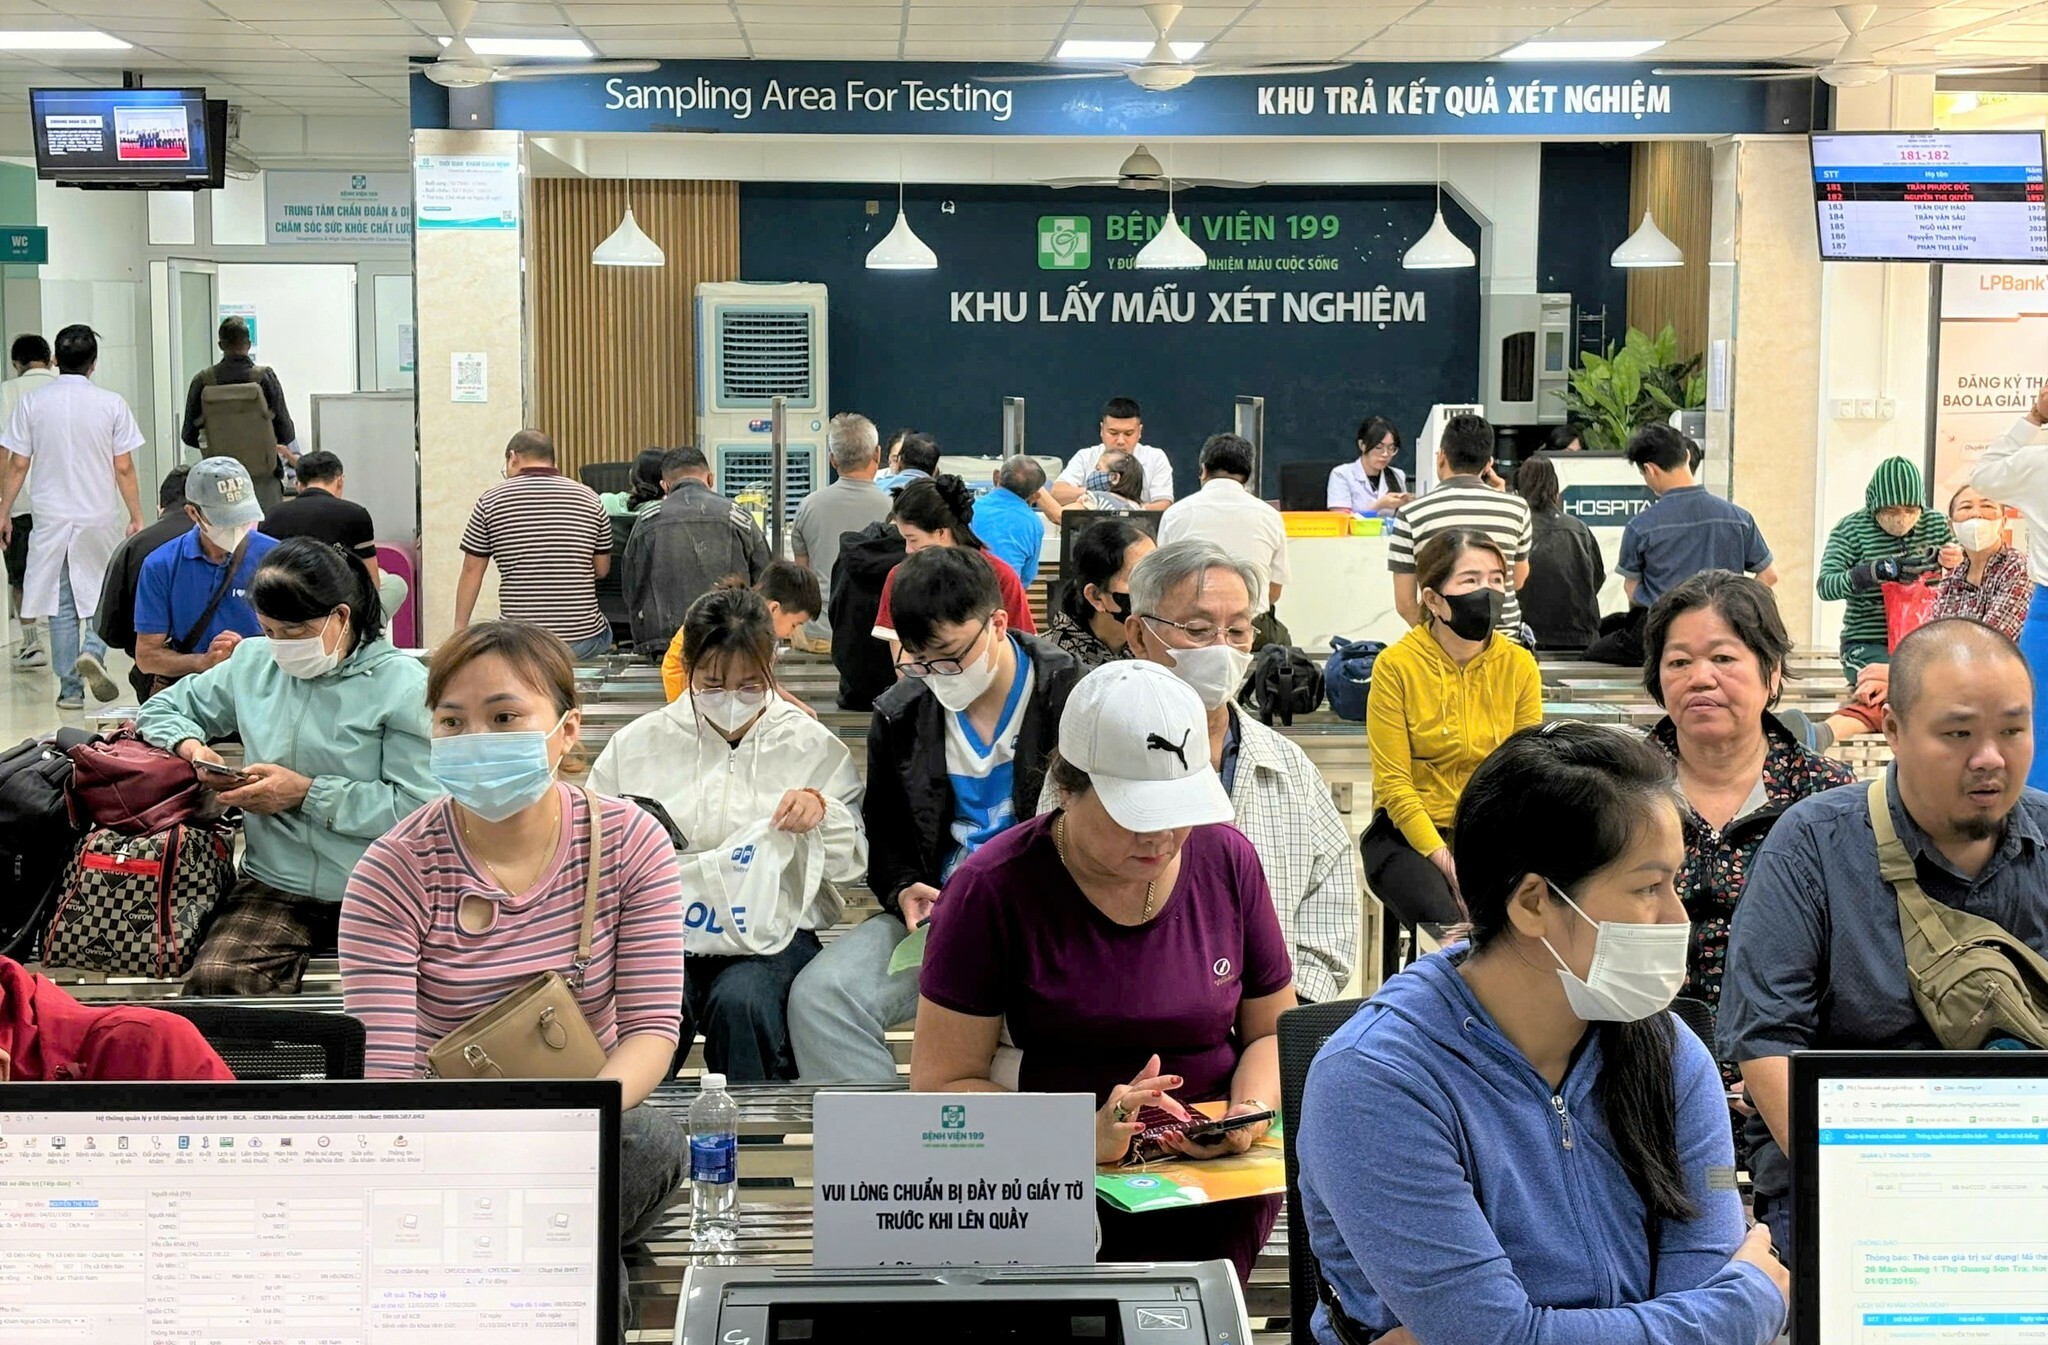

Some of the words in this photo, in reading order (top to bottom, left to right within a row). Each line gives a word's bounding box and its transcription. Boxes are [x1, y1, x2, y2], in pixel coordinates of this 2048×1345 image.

[605, 77, 752, 119] Sampling
[762, 80, 836, 111] Area
[847, 81, 898, 112] For
[902, 81, 1013, 121] Testing
[1257, 86, 1314, 114] KHU
[1324, 78, 1377, 114] TRẢ
[1387, 78, 1441, 115] KẾT
[1444, 76, 1500, 118] QUẢ
[1507, 79, 1558, 114] XÉT
[1564, 80, 1671, 120] NGHIỆM
[1900, 150, 1950, 160] 181-182
[1823, 170, 1839, 179] STT
[284, 205, 313, 216] TRUNG
[315, 203, 334, 217] TÂM
[391, 206, 398, 217] &
[275, 221, 301, 233] CHĂM
[304, 221, 322, 233] SÓC
[1202, 210, 1275, 246] VIỆN
[1286, 215, 1339, 240] 199
[11, 235, 28, 247] WC
[1107, 259, 1115, 270] Y
[1208, 256, 1244, 273] NHIỆM
[1247, 256, 1271, 271] MÀU
[1275, 256, 1305, 274] CUỘC
[1307, 253, 1339, 271] SỐNG
[1980, 275, 2045, 291] LPBank
[950, 291, 1028, 322] KHU
[1039, 281, 1105, 322] LẤY
[1112, 283, 1195, 323] MẪU
[1207, 285, 1276, 323] XÉT
[1282, 285, 1426, 330] NGHIỆM
[1958, 373, 2001, 389] ĐĂNG
[1943, 395, 1973, 407] BAO
[1976, 395, 1993, 407] LA
[1995, 391, 2026, 407] GIẢI
[216, 477, 244, 494] CAP
[1563, 499, 1659, 516] HOSPITA
[922, 1130, 946, 1142] BỆNH
[947, 1130, 967, 1142] VIỆN
[968, 1132, 985, 1140] 199
[821, 1184, 845, 1201] VUI
[850, 1181, 888, 1201] LÒNG
[893, 1177, 942, 1201] CHUẨN
[948, 1184, 962, 1204] BỊ
[967, 1177, 997, 1201] ĐẦY
[1002, 1178, 1021, 1201] ĐỦ
[1027, 1178, 1060, 1201] GIẤY
[1065, 1180, 1084, 1201] TỜ
[876, 1209, 924, 1230] TRƯỚC
[929, 1213, 952, 1230] KHI
[958, 1209, 985, 1230] LÊN
[989, 1207, 1029, 1230] QUẦY
[1900, 1265, 1930, 1273] Quang
[1961, 1265, 1990, 1273] Quang
